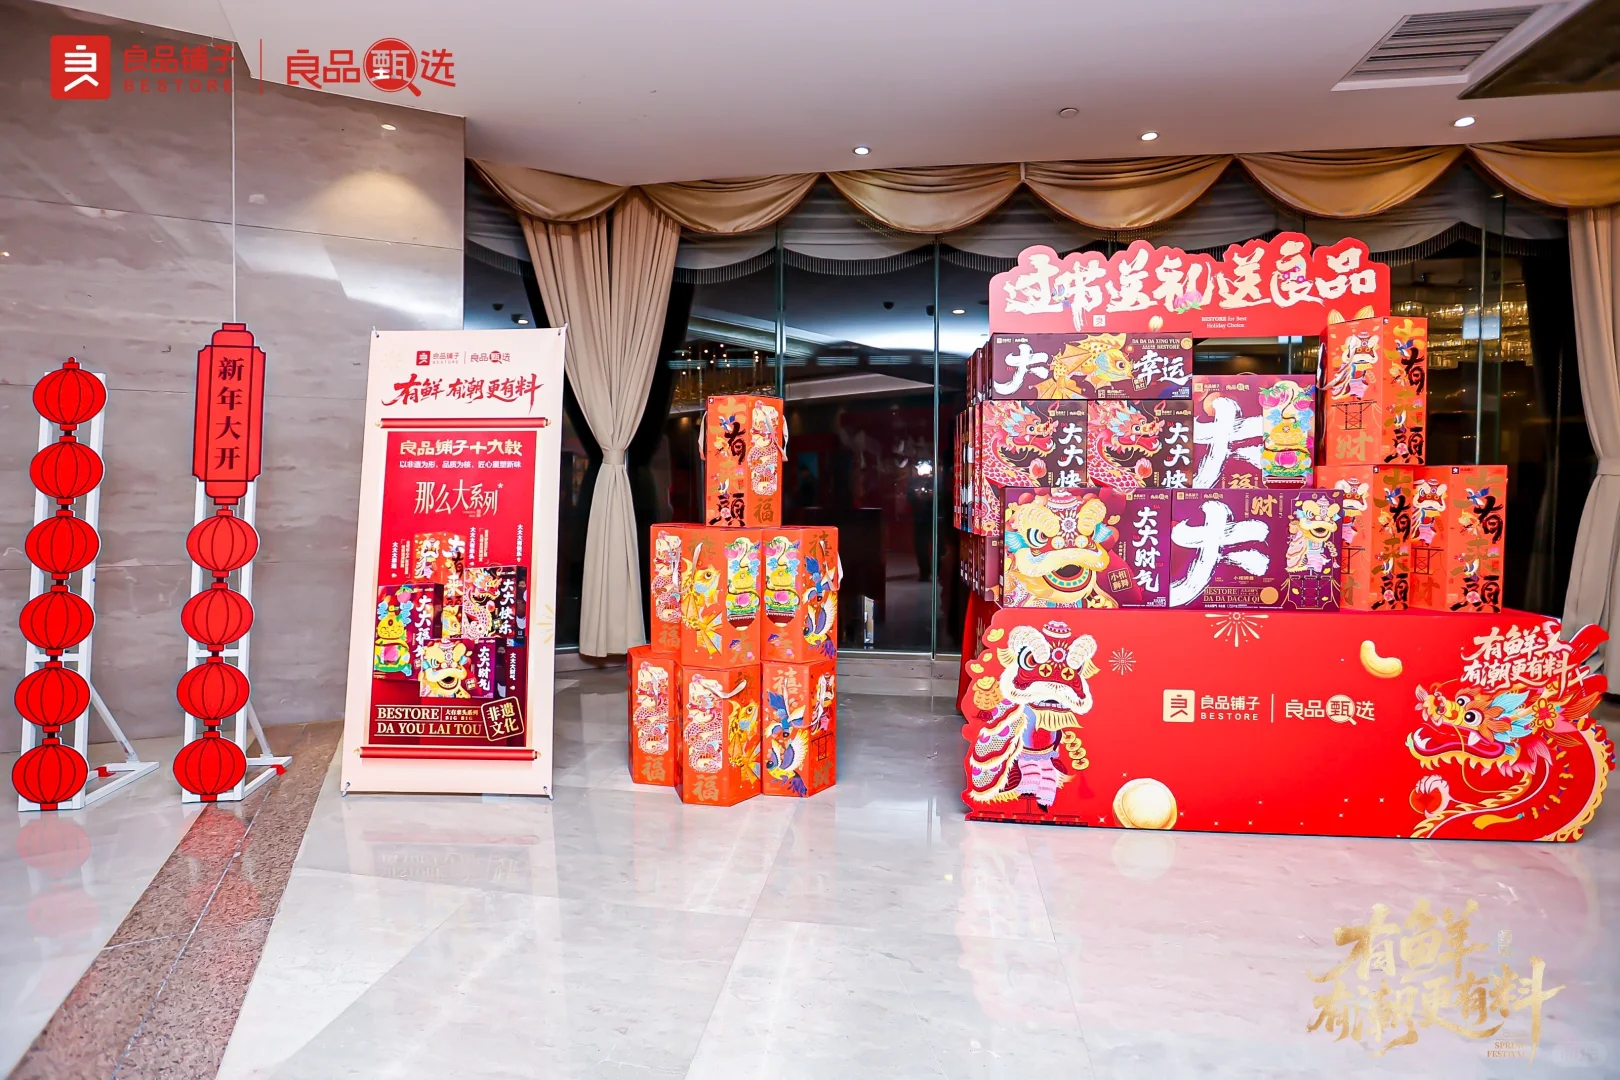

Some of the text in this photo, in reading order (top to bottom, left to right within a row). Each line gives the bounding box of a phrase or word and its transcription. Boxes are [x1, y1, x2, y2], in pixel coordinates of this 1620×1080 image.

[993, 344, 1192, 395] 大 幸运
[213, 356, 245, 470] 新年大开
[413, 478, 499, 516] 那么大系列
[753, 498, 774, 524] 福
[1250, 494, 1278, 518] 财
[1132, 506, 1161, 593] 大大财气
[1169, 500, 1271, 608] 大
[498, 578, 516, 635] 大大快乐
[658, 624, 681, 649] 福
[1461, 625, 1544, 662] 有鲜
[476, 645, 492, 691] 大大财气
[1461, 653, 1578, 699] 有潮更有料
[377, 707, 440, 720] BESTORE
[1200, 695, 1261, 711] 良品铺子
[1200, 712, 1259, 721] BESTORE
[1285, 694, 1376, 725] 良品甄选
[376, 722, 482, 735] DA YOU LAI TOU
[490, 718, 519, 738] 文化
[641, 757, 665, 783] 福
[693, 775, 719, 802] 福
